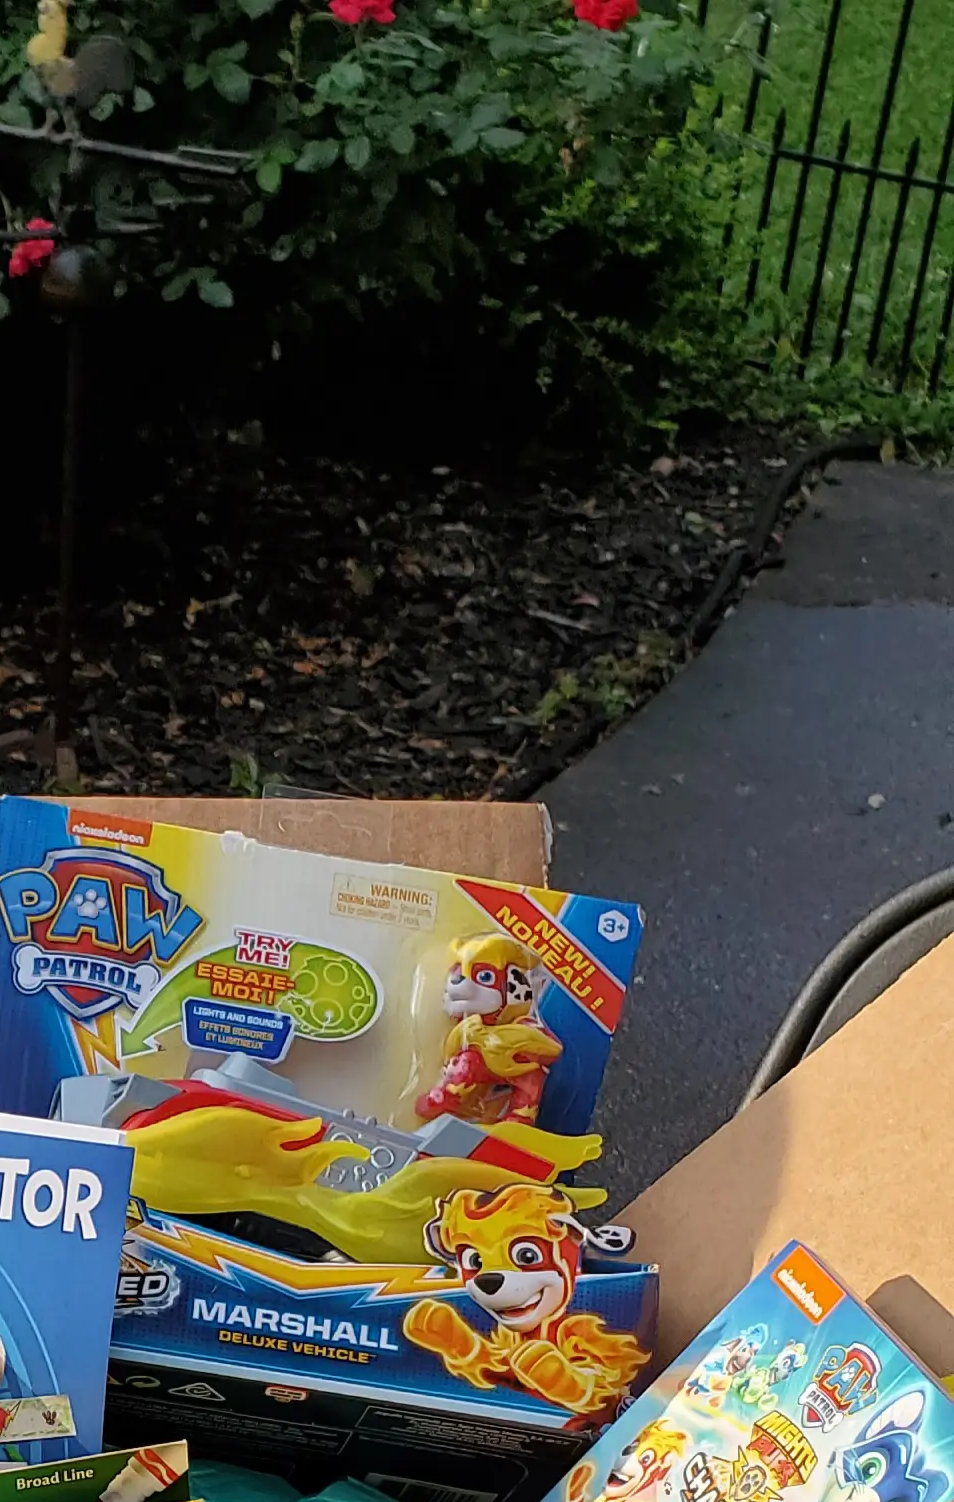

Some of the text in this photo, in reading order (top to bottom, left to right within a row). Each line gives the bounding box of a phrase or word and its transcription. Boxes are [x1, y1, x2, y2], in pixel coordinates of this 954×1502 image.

[72, 823, 145, 845] nickelodeon
[370, 883, 433, 906] WARNING:
[602, 917, 627, 934] 3+
[238, 930, 295, 952] TRY
[534, 919, 597, 979] NEW!
[237, 947, 290, 968] ME!
[33, 956, 142, 995] PATROL
[196, 961, 296, 991] ESSAIE-
[192, 1005, 284, 1029] LIGHTS AND SOUNDS
[192, 1298, 399, 1352] MARSHALL
[219, 1329, 370, 1364] DELUXE VEHICLE
[814, 1345, 880, 1417] PAW
[805, 1389, 837, 1426] PATROL
[756, 1410, 819, 1477] MIGHTY
[15, 1466, 95, 1491] Broad Line
